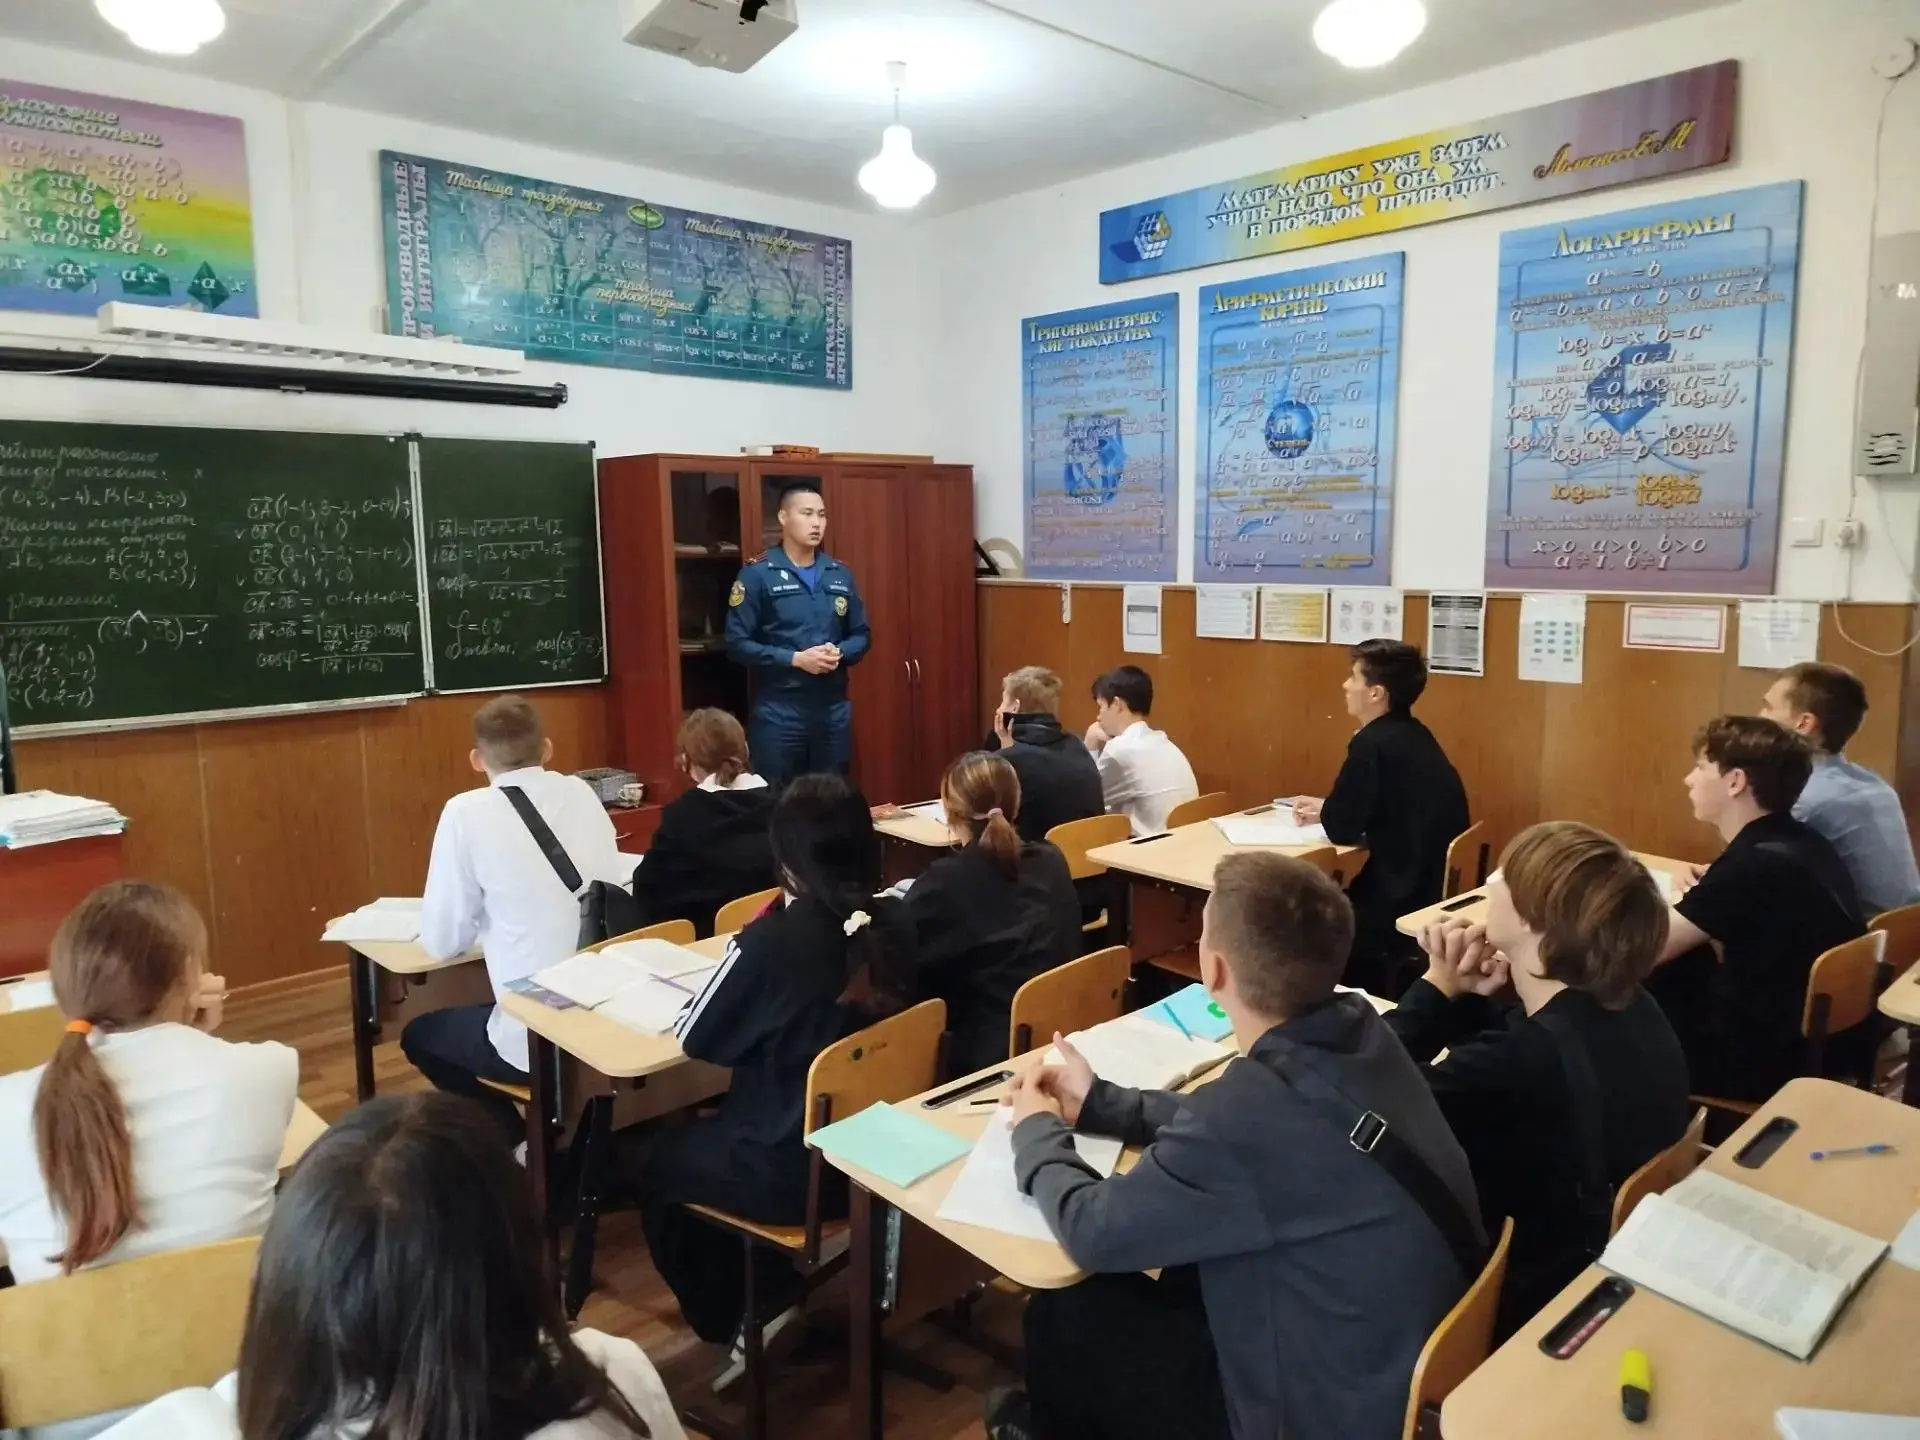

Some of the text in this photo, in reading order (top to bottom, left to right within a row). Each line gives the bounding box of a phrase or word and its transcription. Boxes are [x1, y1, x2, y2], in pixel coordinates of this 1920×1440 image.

[1207, 207, 1272, 229] УЧИТЬ
[1278, 191, 1332, 215] НАДО
[1342, 179, 1386, 200] ЧТО
[1395, 167, 1440, 190] ОНА
[1216, 132, 1509, 211] МАТЕМАТИКУ УЖЕ ЗАТЕМ
[393, 161, 417, 338] ПРОИЗВОДНЫЕ
[412, 164, 436, 340] И ИНТЕГРАЛЫ
[1248, 223, 1262, 239] В
[1269, 204, 1365, 234] ПОРЯДОК
[1259, 298, 1329, 322] КОРЕНЬ
[1039, 329, 1152, 354] КИЕ ТОЖДЕСТВА
